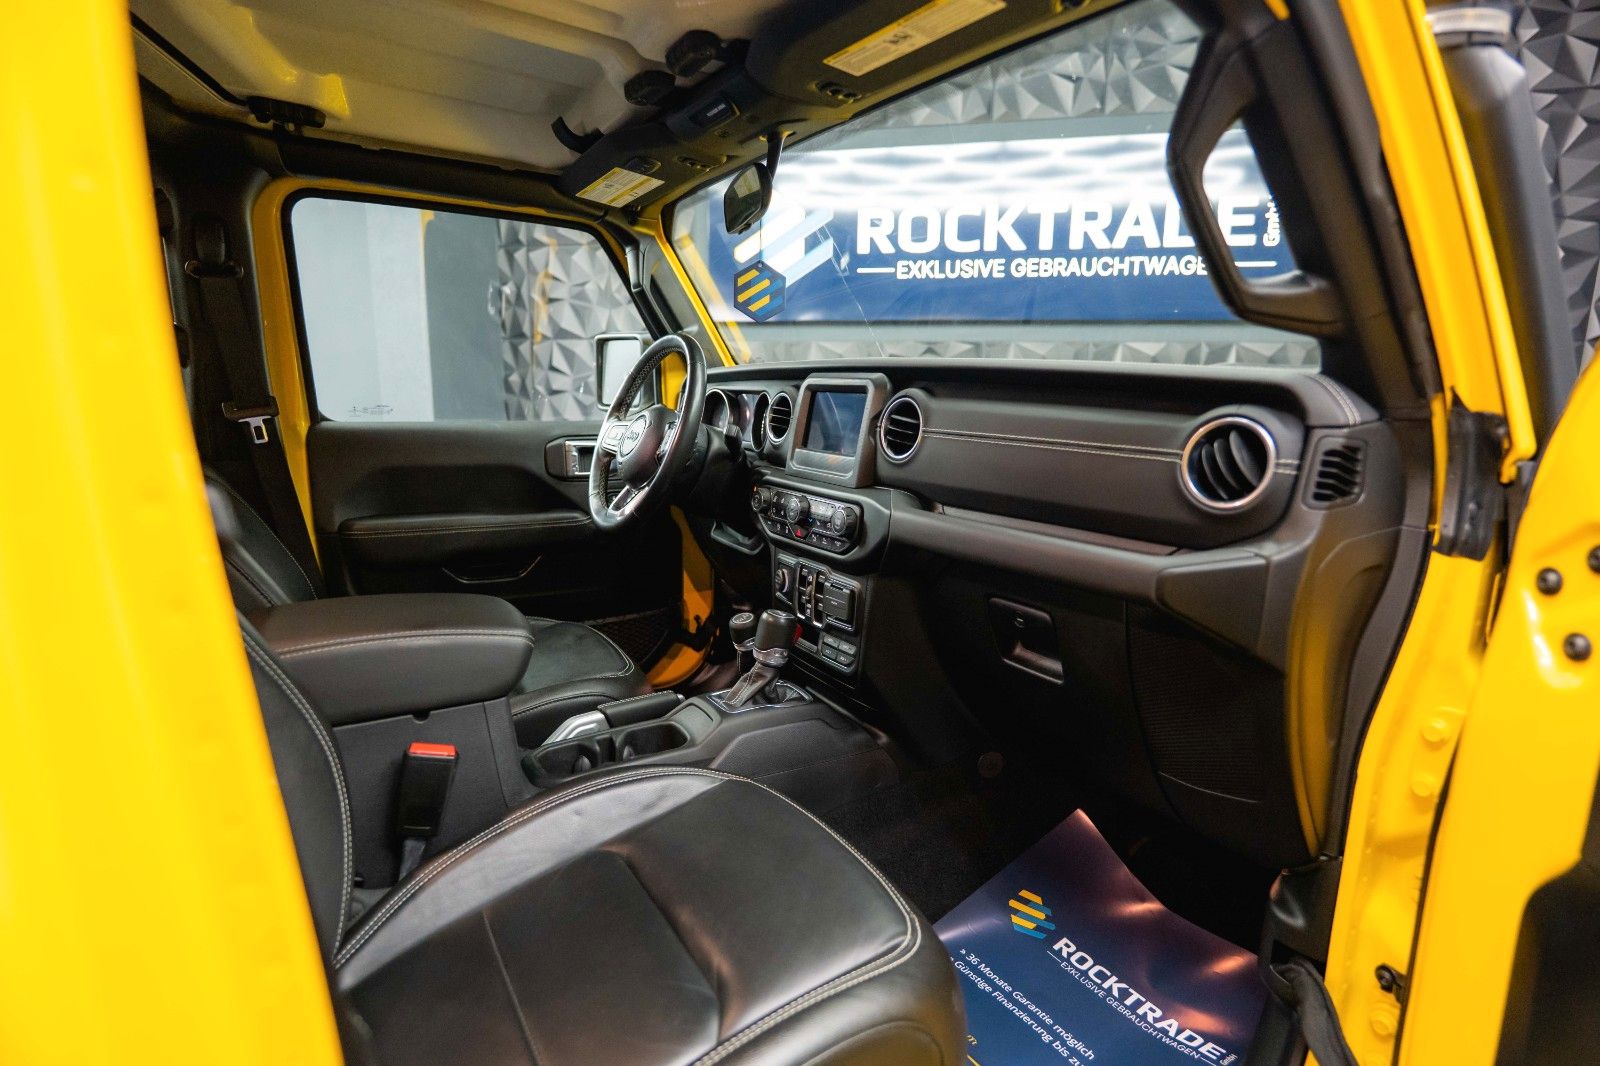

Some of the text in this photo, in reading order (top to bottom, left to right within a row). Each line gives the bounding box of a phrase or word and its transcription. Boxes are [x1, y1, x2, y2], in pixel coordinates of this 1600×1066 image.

[896, 254, 1209, 280] EXKLUSIVE GEBRAUCHTWAGE
[954, 960, 993, 993] Günstige
[991, 991, 1054, 1044] Finanzierung
[1052, 1040, 1070, 1058] bis
[965, 953, 1096, 1060] 36 Monate Garantie möglich
[1053, 937, 1227, 1060] ROCKTRADE
[1060, 961, 1200, 1059] EXKLUSIVE GEBRAUCHTWAGEN
